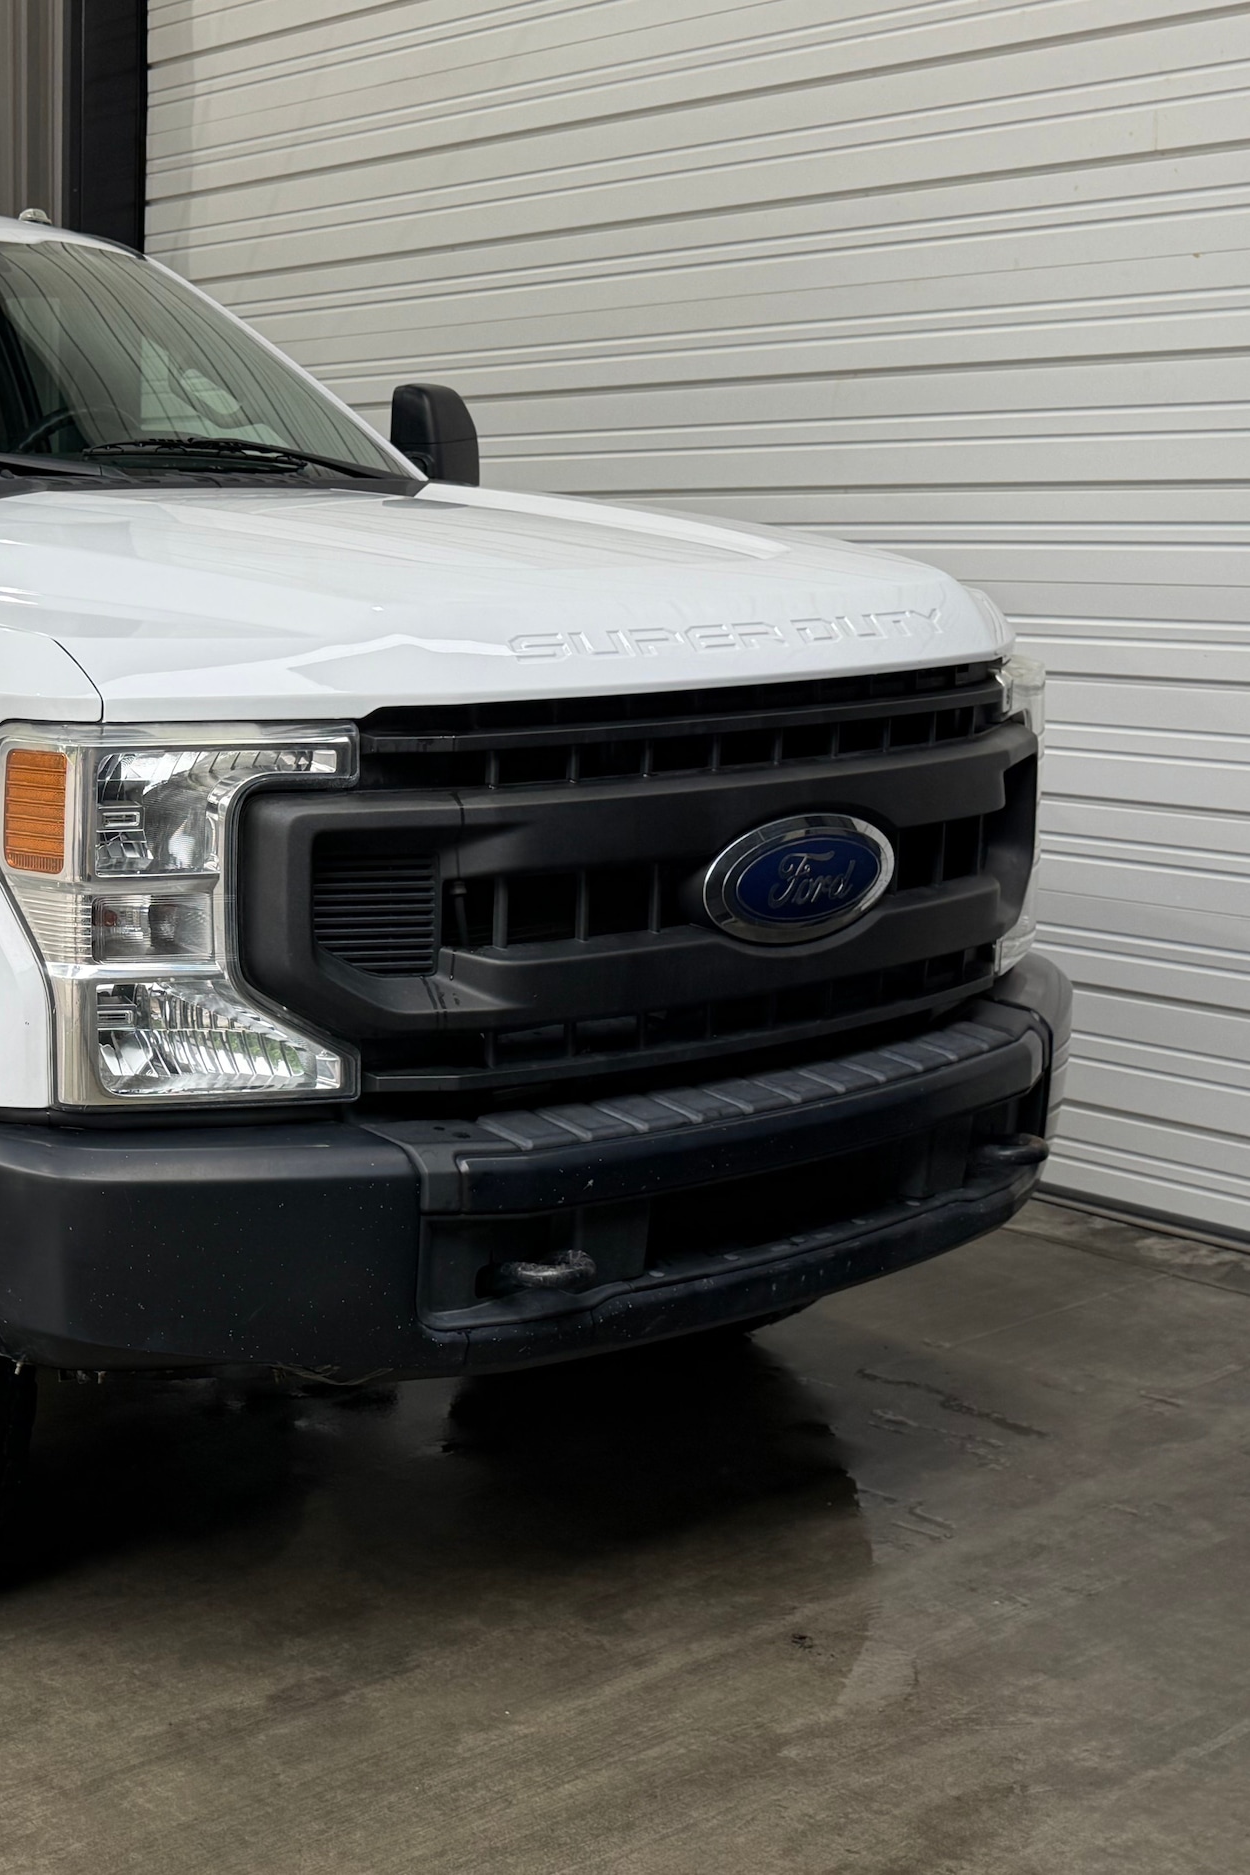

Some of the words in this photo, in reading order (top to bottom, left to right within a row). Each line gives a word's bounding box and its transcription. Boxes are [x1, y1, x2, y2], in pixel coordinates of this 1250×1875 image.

[507, 622, 788, 665] SUPER
[790, 607, 943, 644] DUTY
[768, 850, 856, 909] Ford
